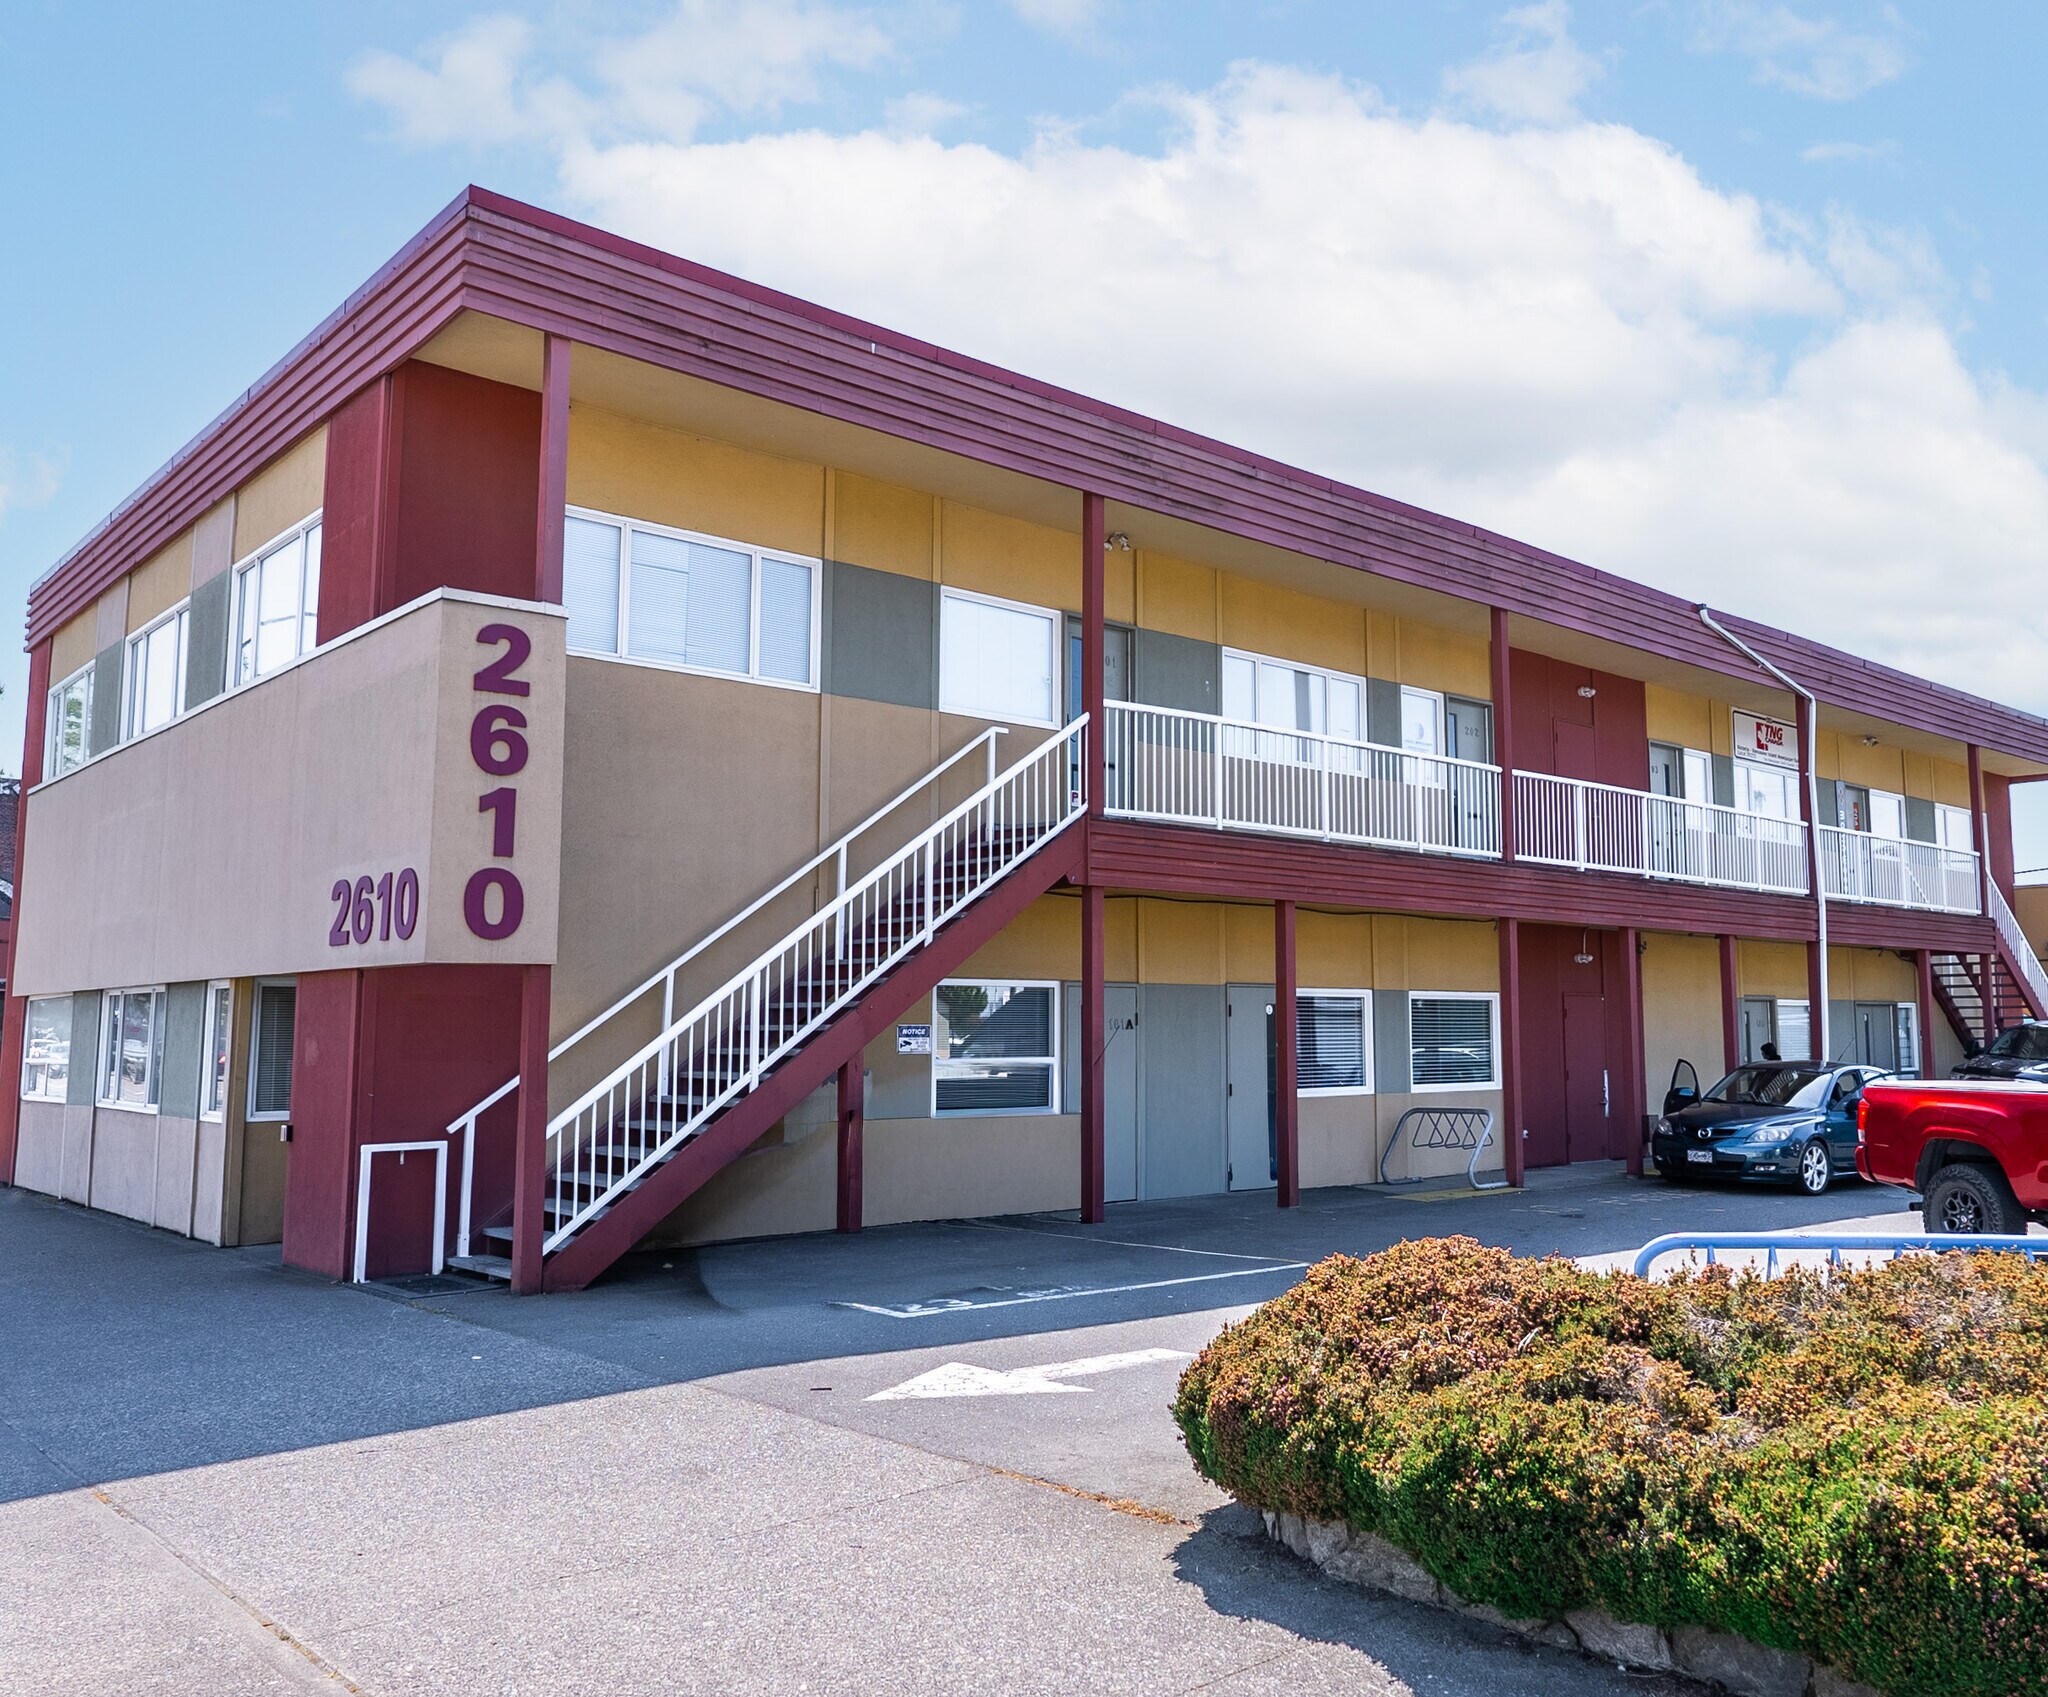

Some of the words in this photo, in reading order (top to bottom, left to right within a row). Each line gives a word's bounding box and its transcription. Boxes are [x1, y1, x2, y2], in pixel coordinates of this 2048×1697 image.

[1464, 726, 1480, 738] 202
[1764, 724, 1783, 741] TNG
[463, 623, 532, 941] 2610
[329, 868, 419, 946] 2610
